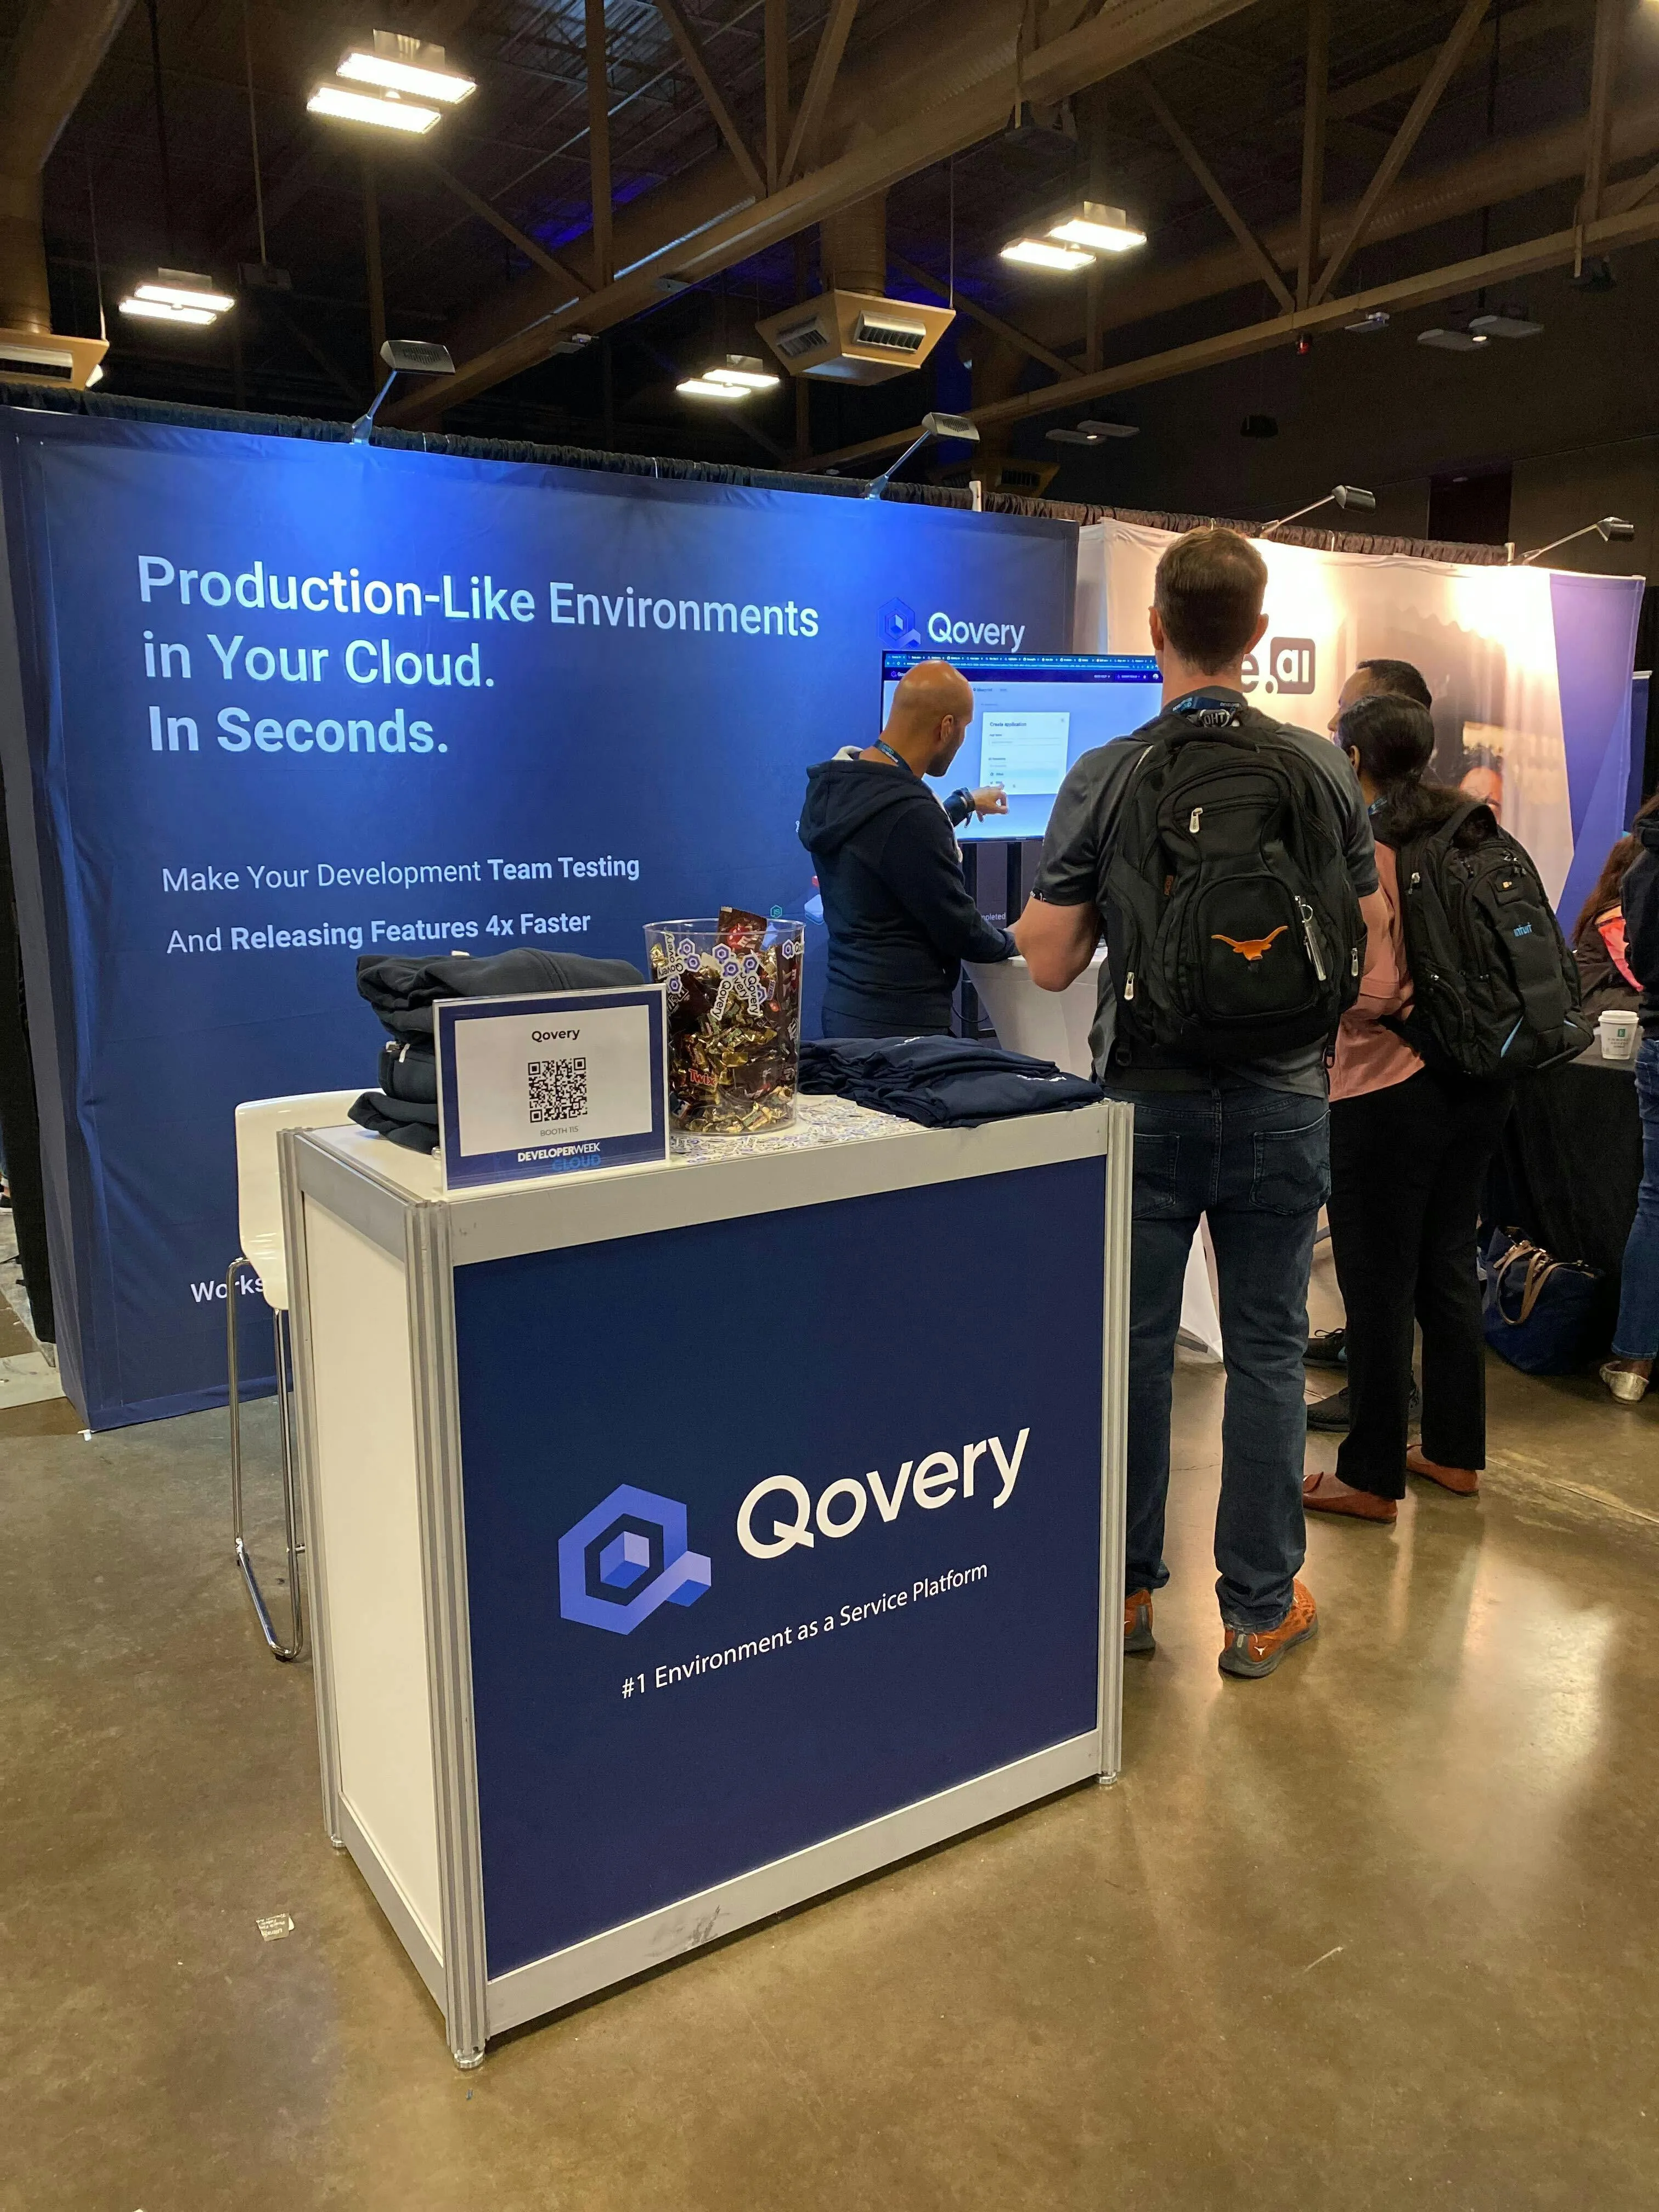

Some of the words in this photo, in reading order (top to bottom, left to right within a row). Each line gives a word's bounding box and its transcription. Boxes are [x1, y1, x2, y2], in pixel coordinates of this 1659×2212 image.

[138, 555, 535, 622] Production-Like
[550, 582, 819, 637] Environments
[928, 612, 1025, 653] Qovery
[143, 630, 191, 678] in
[207, 634, 329, 681] Your
[345, 639, 494, 687] Cloud.
[148, 706, 199, 752] In
[217, 707, 448, 753] Seconds.
[162, 868, 239, 892] Make
[247, 865, 309, 889] Your
[318, 861, 481, 889] Development
[487, 858, 552, 881] Team
[557, 855, 640, 881] Testing
[166, 928, 221, 953] And
[230, 924, 363, 950] Releasing
[371, 918, 479, 943] Features
[485, 915, 514, 936] 4x
[520, 911, 591, 935] Faster
[665, 934, 675, 963] overy
[712, 980, 731, 1018] Qovery
[748, 976, 758, 1013] Qovery
[532, 1029, 580, 1042] Qovery
[540, 1128, 567, 1136] BOOTH
[518, 1142, 600, 1162] DEVELOPERWEEK
[737, 1427, 1030, 1559] Qovery
[621, 1673, 646, 1699] #1
[656, 1626, 792, 1688] Environment
[797, 1621, 818, 1641] as
[824, 1613, 834, 1633] a
[840, 1590, 907, 1626] Service
[913, 1564, 988, 1601] Platform
